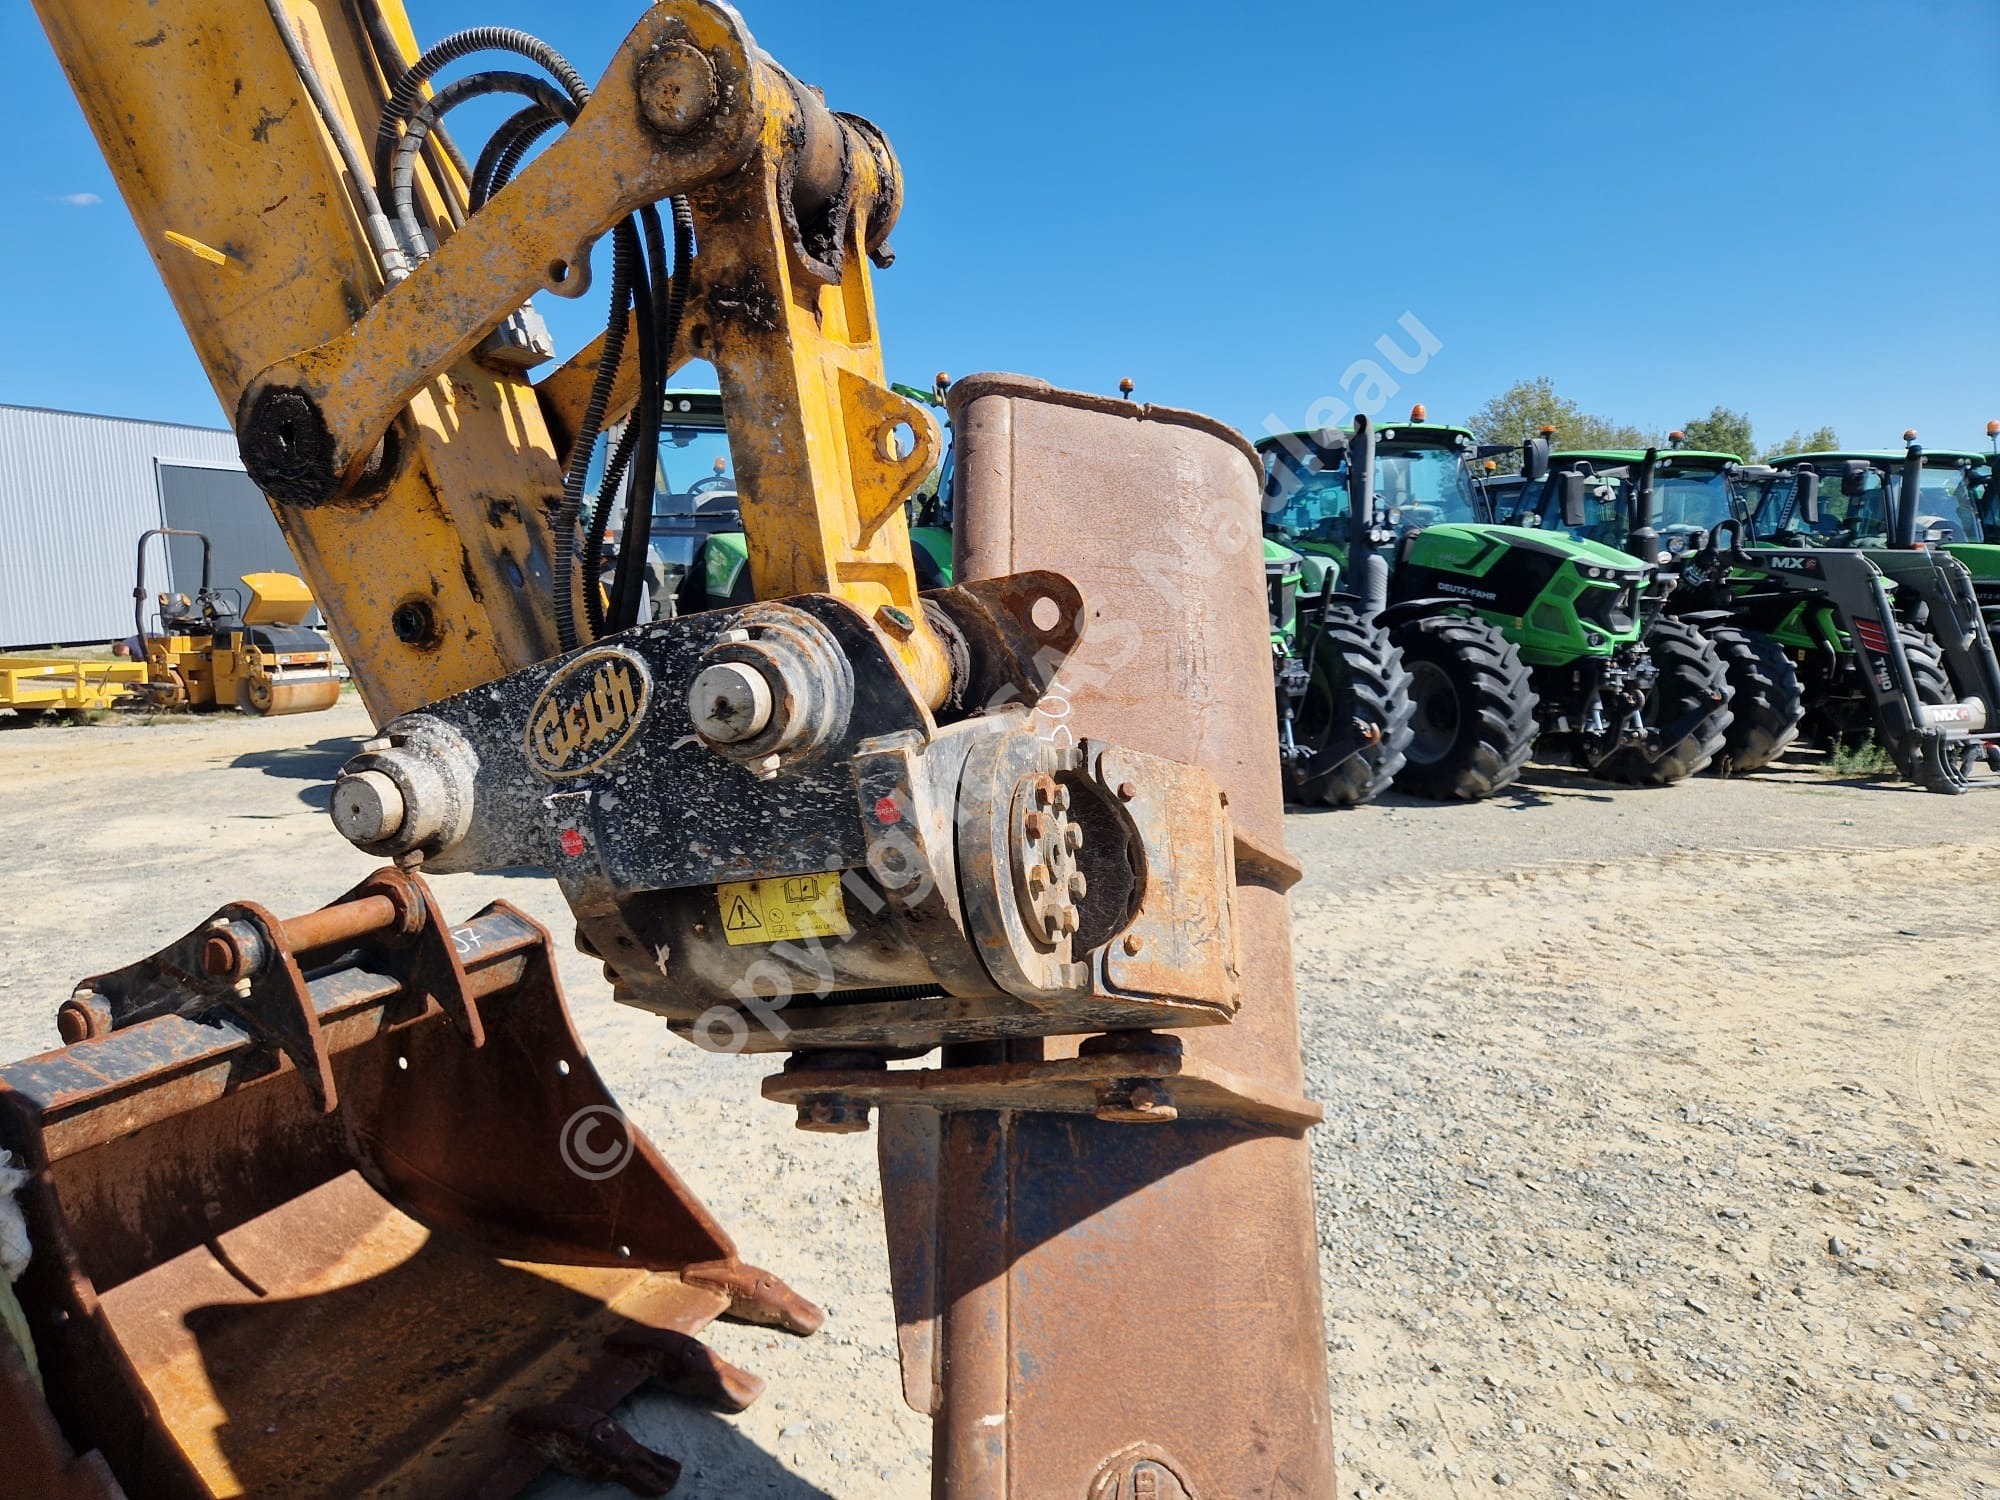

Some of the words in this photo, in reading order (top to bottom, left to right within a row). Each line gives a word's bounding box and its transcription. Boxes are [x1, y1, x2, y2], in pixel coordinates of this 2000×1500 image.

[1771, 556, 1806, 569] MX
[1437, 582, 1496, 600] DEUTZ-FAHR
[1933, 709, 1961, 722] MX
